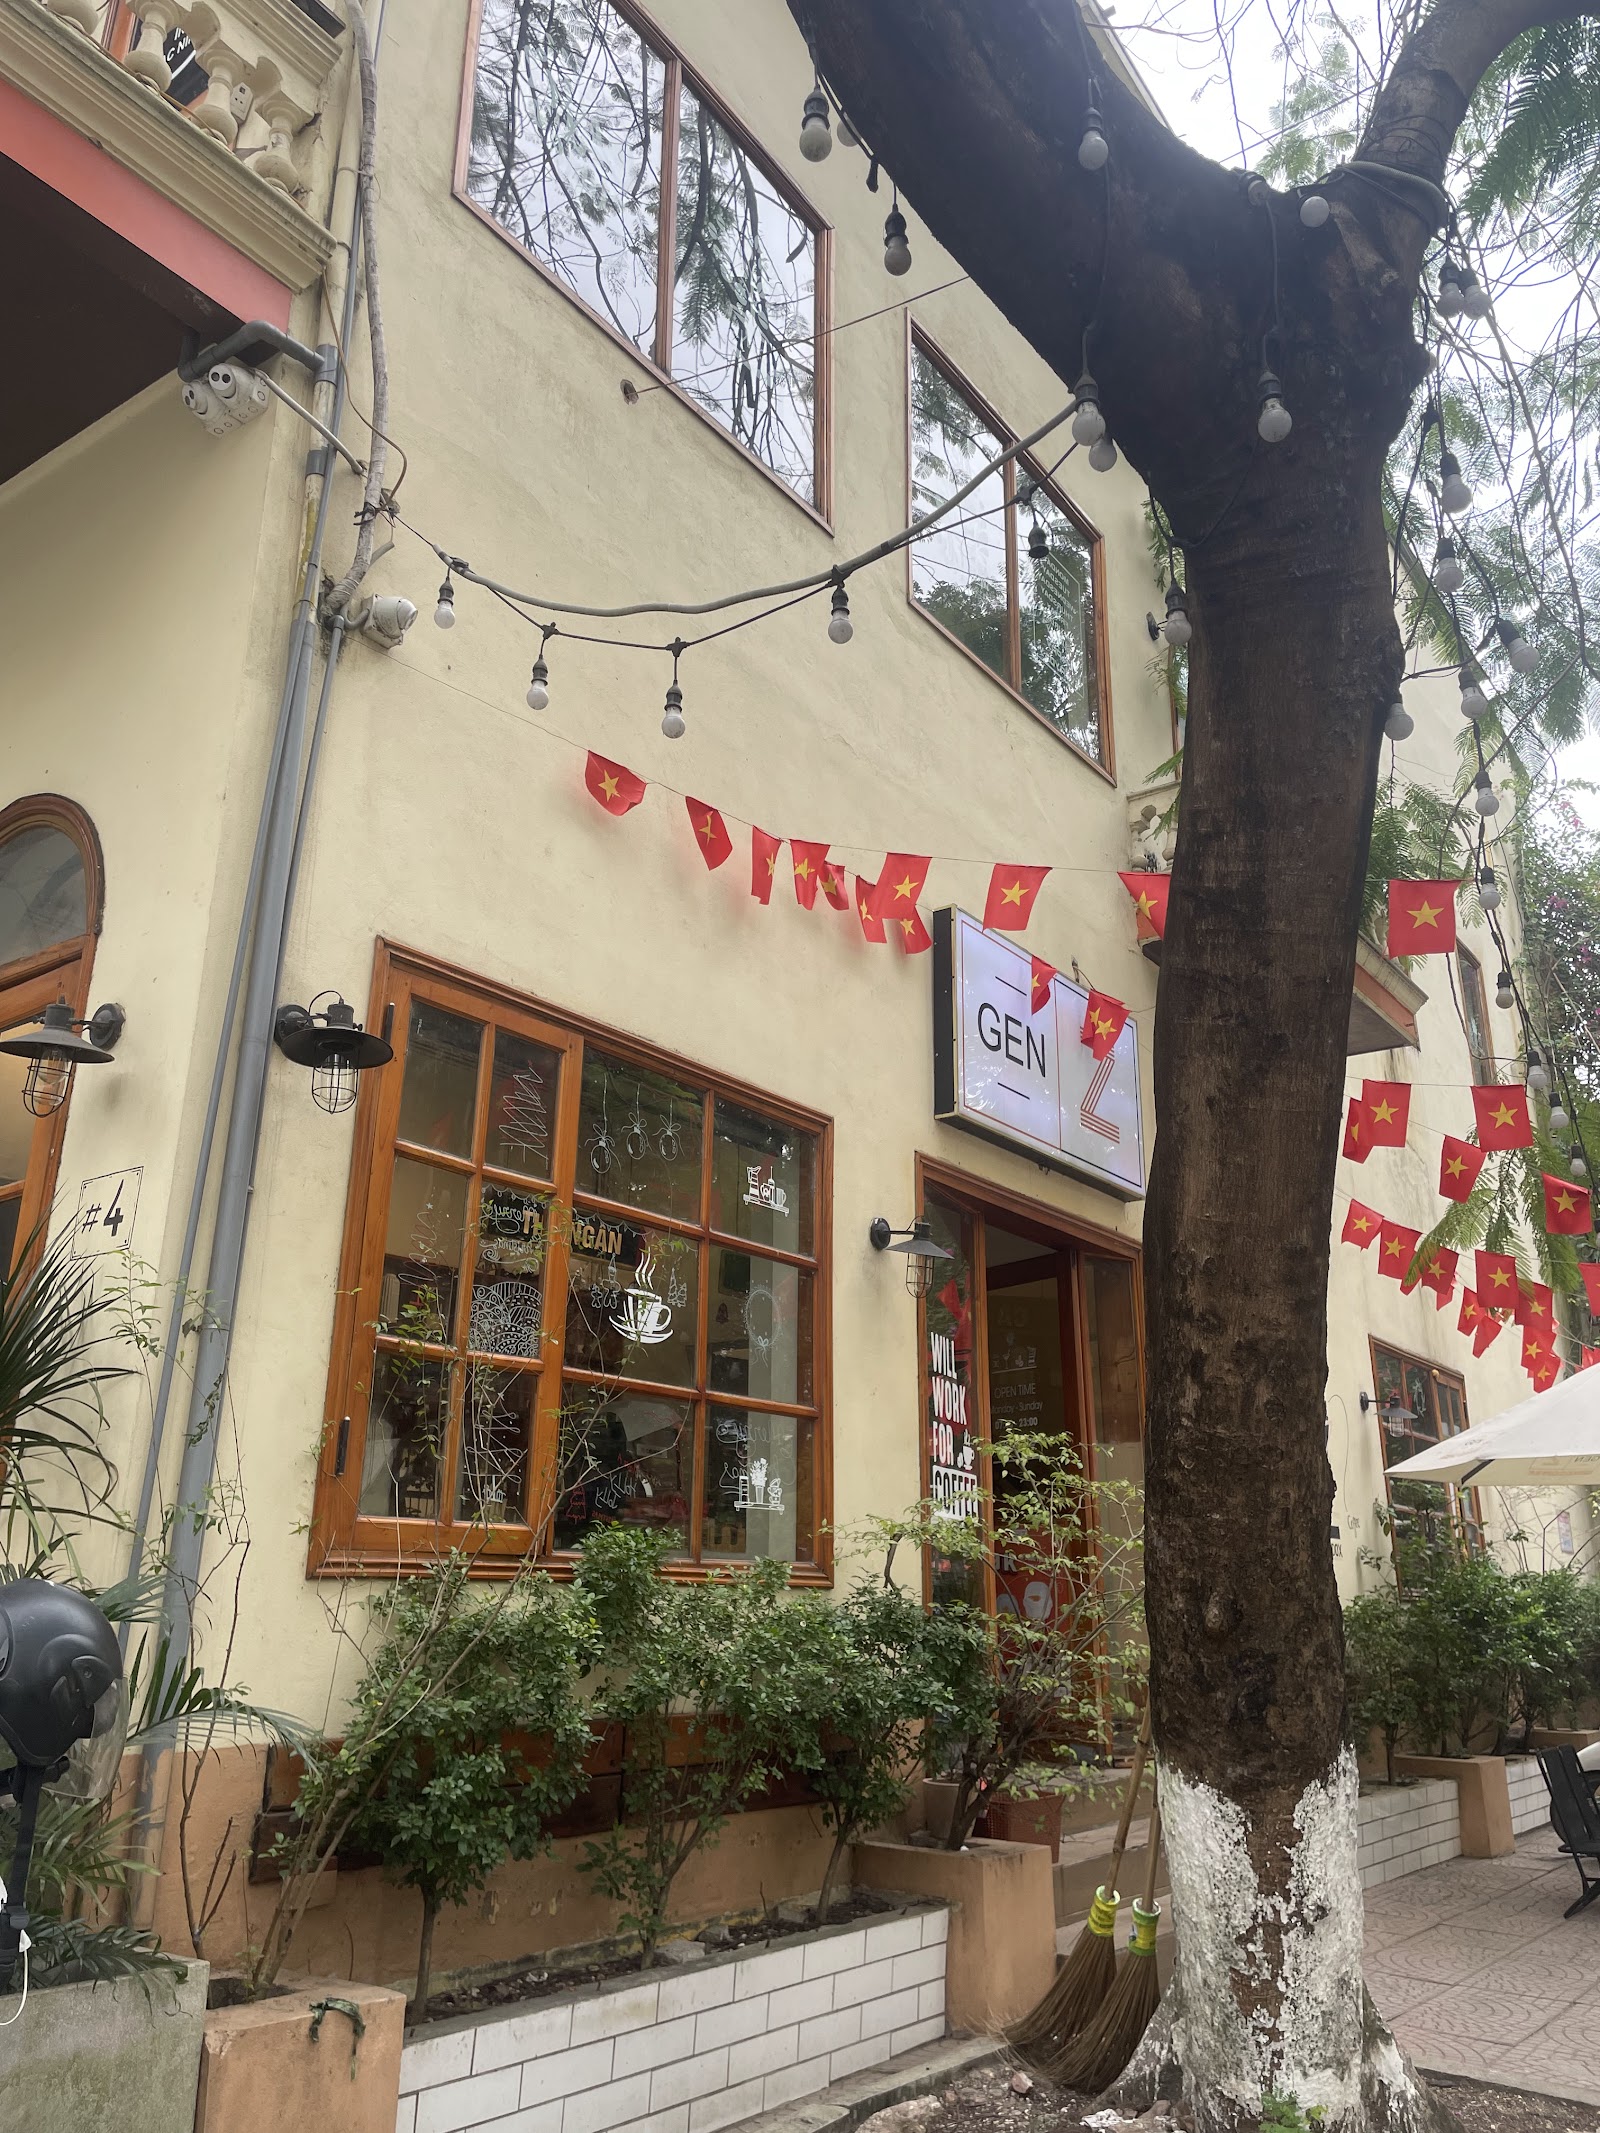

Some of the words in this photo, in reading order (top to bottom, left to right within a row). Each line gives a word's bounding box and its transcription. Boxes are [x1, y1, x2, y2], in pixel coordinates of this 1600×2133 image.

[977, 1002, 1046, 1078] GEN
[82, 1179, 125, 1237] #4
[931, 1332, 957, 1379] WILL
[932, 1376, 967, 1425] WORK
[994, 1386, 1017, 1399] OPEN
[1018, 1382, 1036, 1396] TIME
[1019, 1400, 1043, 1412] Sunday
[932, 1421, 954, 1466] FOR
[1018, 1416, 1038, 1428] 23:00
